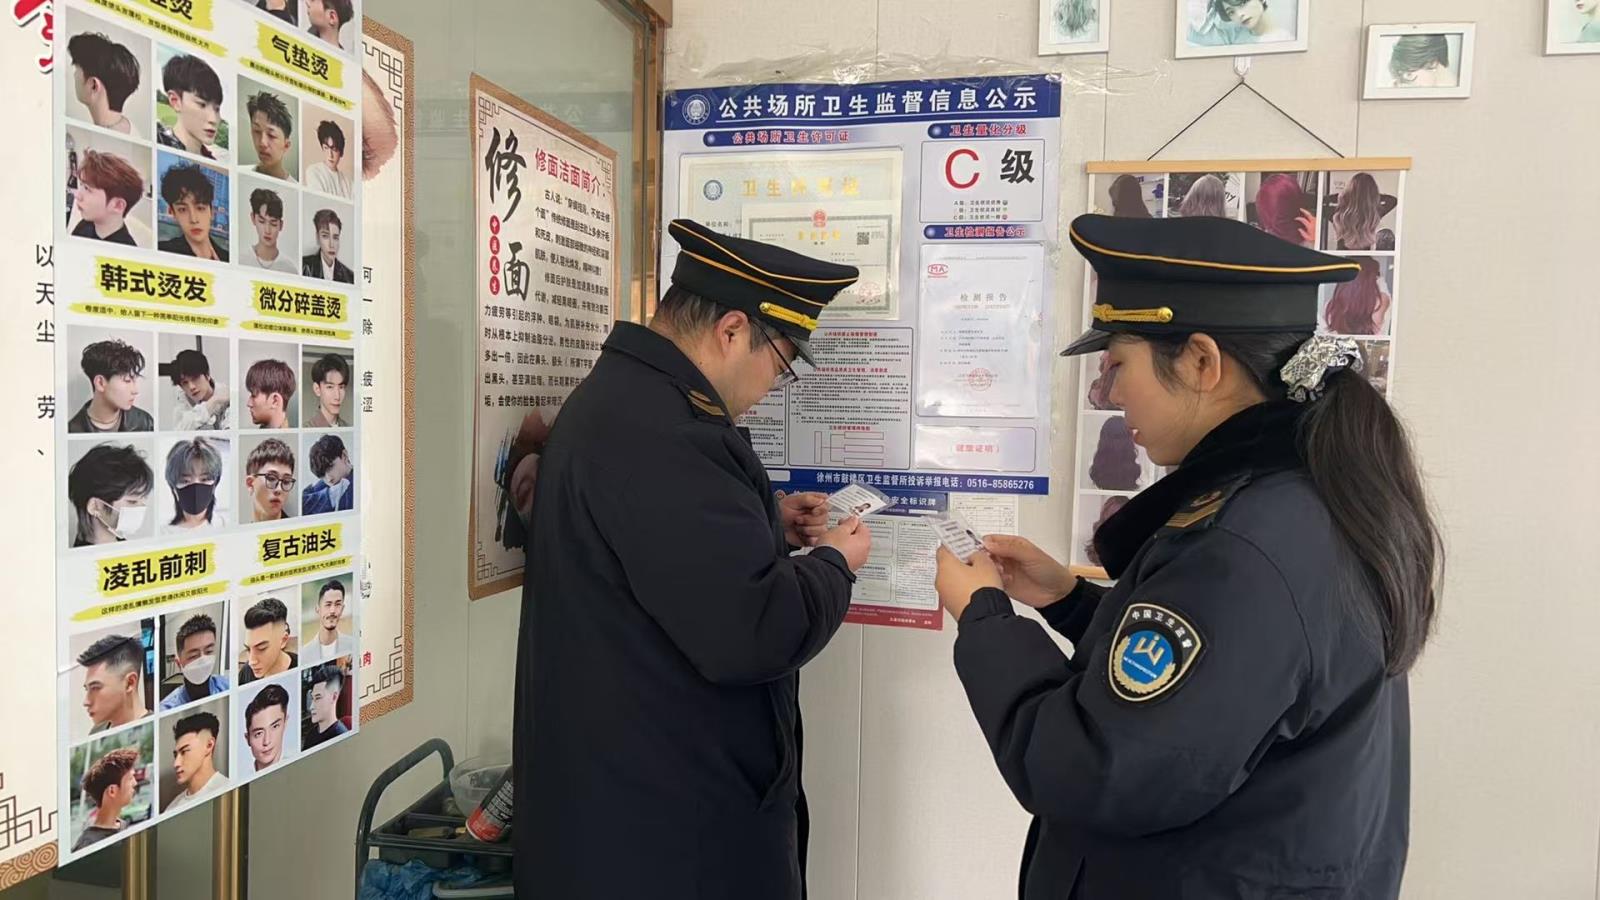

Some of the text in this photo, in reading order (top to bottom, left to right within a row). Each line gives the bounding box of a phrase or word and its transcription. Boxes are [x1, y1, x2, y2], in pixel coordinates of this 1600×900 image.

[272, 35, 328, 80] 气垫烫
[719, 87, 1036, 118] 公共场所卫生监督信息公示
[732, 129, 849, 144] 公共场所卫生许可证
[949, 123, 1027, 137] 卫生量化分级
[534, 147, 606, 198] 修面洁面简介：
[945, 148, 1035, 189] C 级
[944, 226, 1025, 238] 卫生检测报告公示
[100, 263, 207, 302] 韩式烫发
[259, 286, 341, 319] 微分碎盖烫
[262, 529, 337, 562] 复古油头
[102, 549, 207, 591] 凌乱前刺
[1131, 609, 1193, 648] 中国卫生监督
